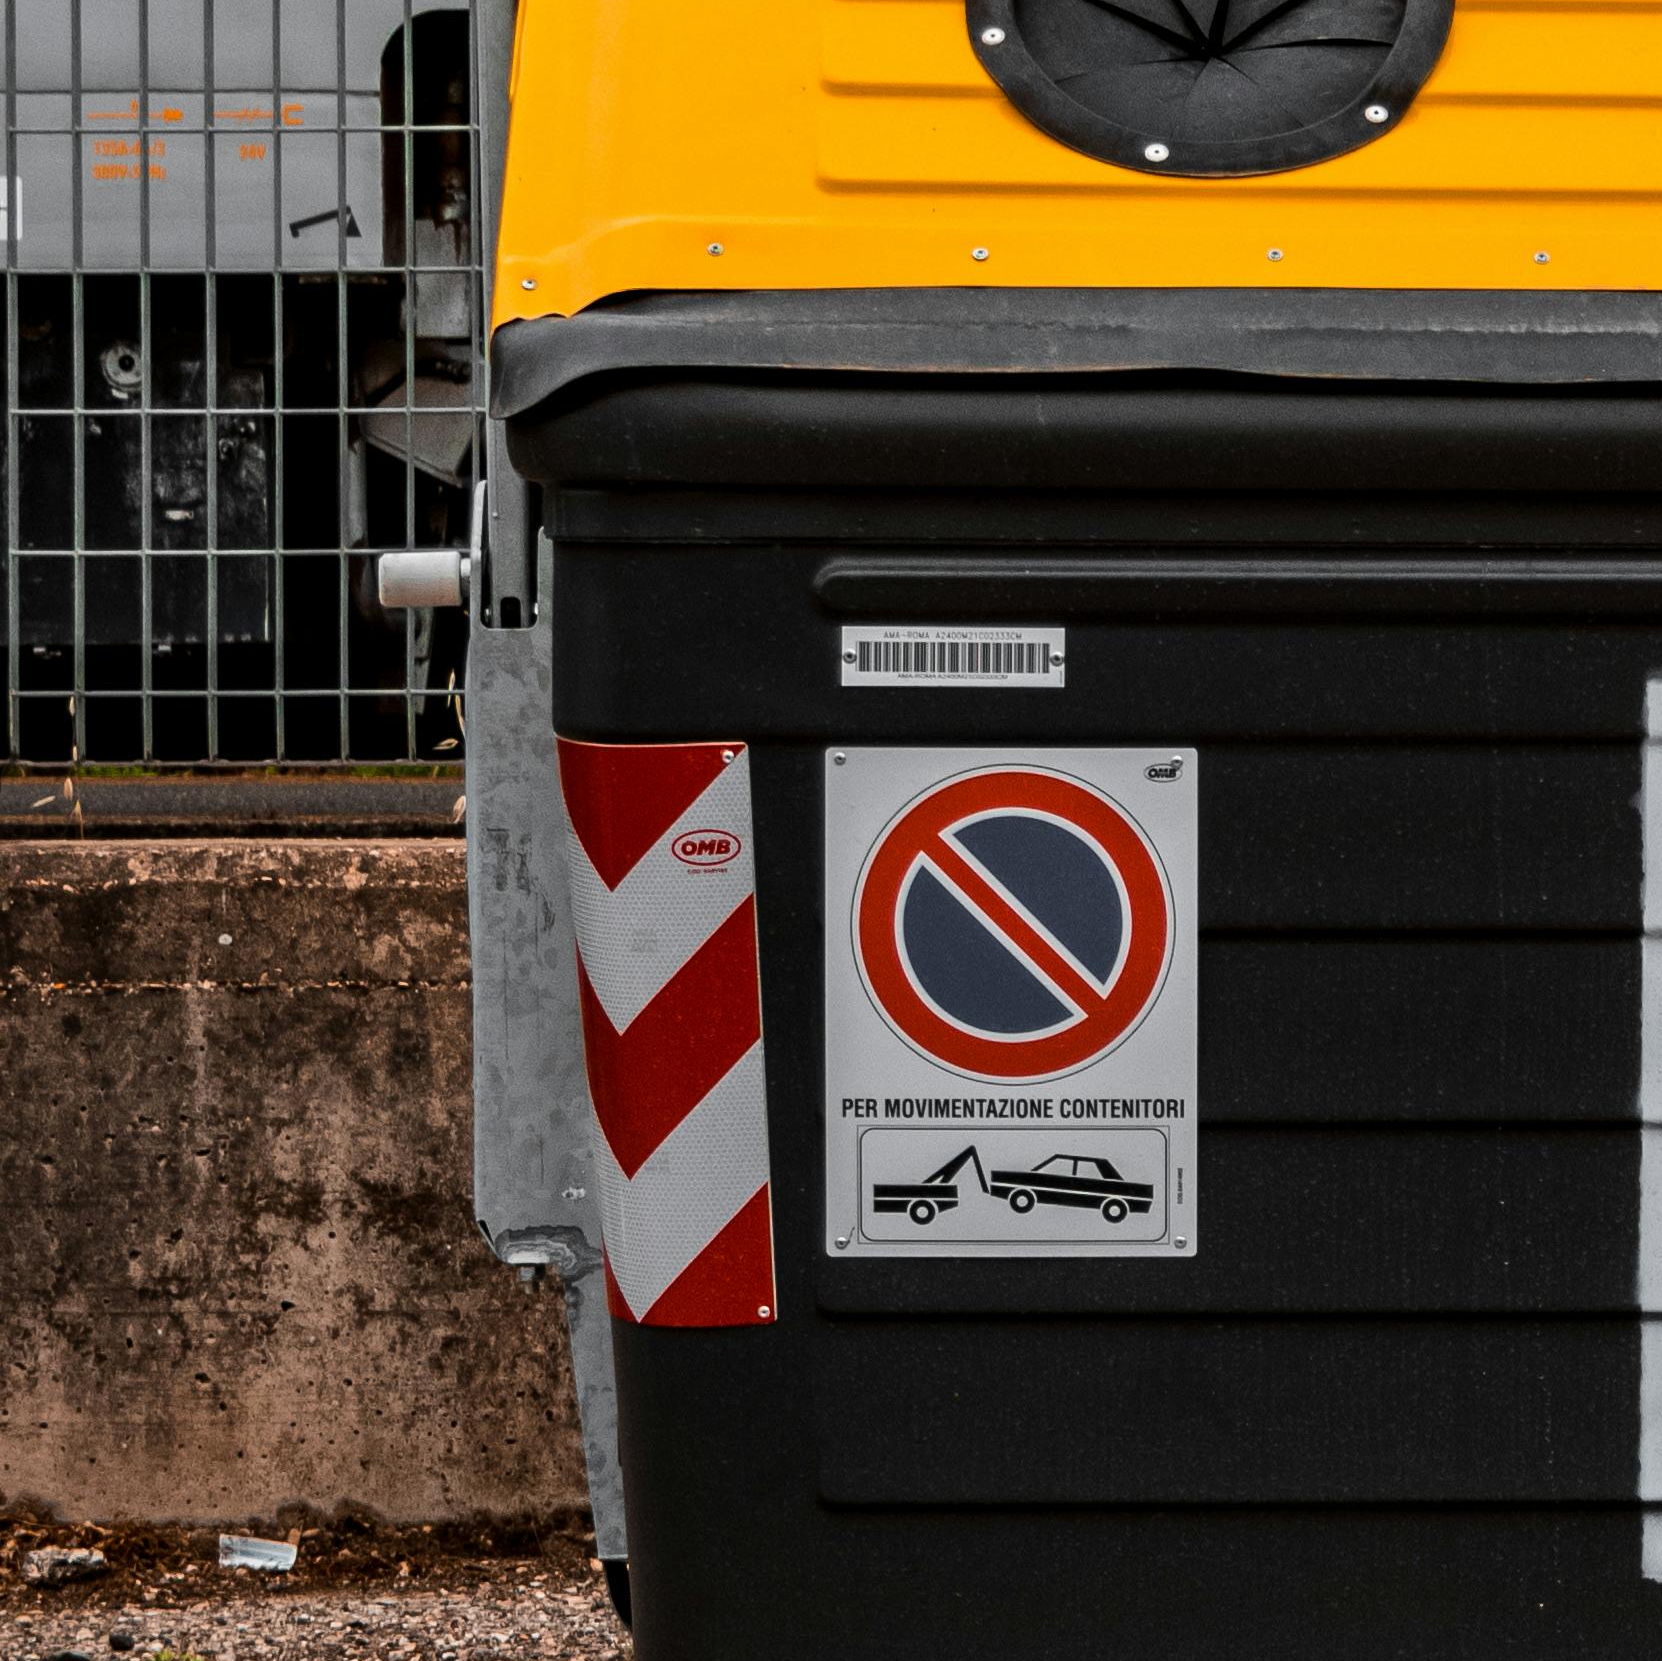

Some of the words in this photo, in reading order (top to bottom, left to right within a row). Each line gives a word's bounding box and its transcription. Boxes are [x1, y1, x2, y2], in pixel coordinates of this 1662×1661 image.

[682, 840, 731, 855] OMB
[842, 1099, 877, 1118] PER
[885, 1099, 1053, 1118] MOVIMENTAZIONE
[1060, 1099, 1184, 1118] CONTENITORI
